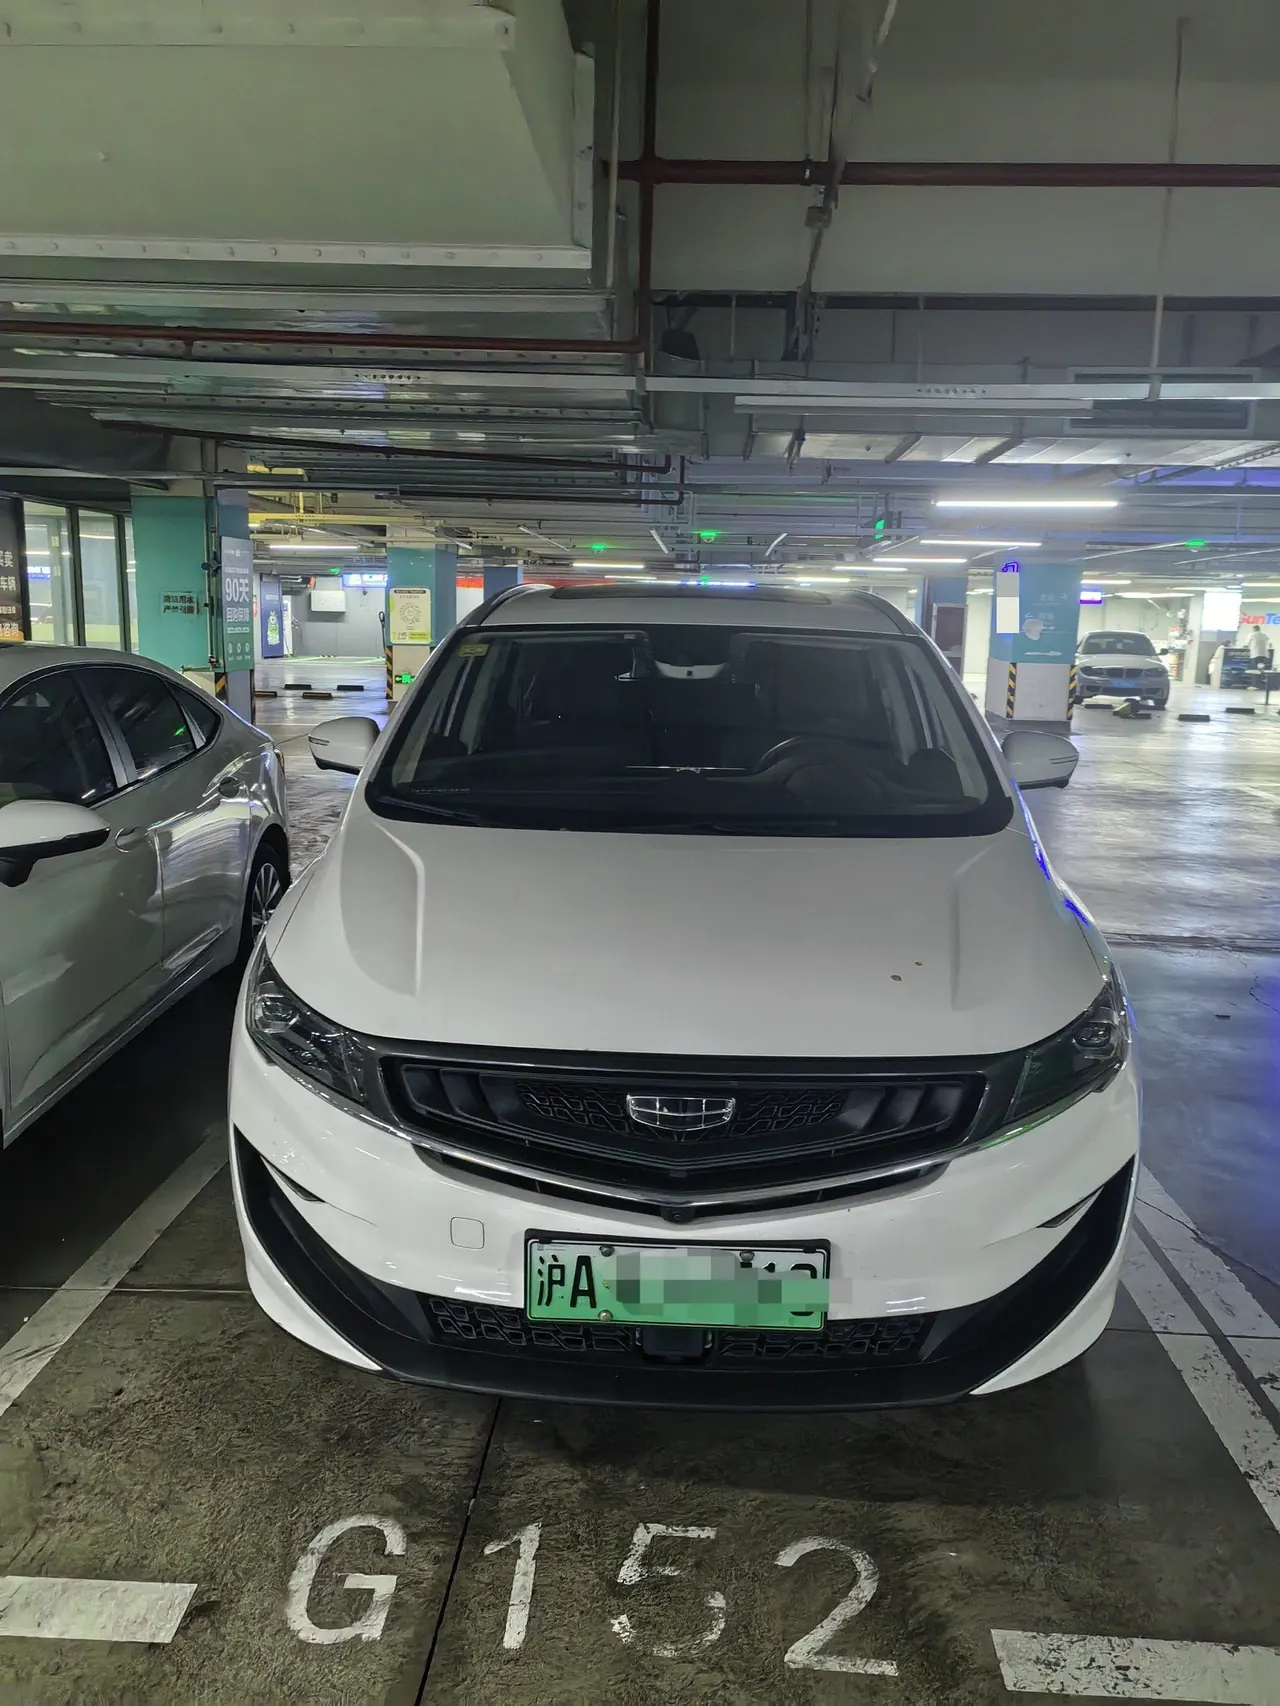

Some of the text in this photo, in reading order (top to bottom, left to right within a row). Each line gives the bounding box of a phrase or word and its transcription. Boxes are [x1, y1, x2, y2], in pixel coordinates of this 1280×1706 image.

[225, 577, 250, 603] 90天
[0, 622, 19, 637] 咨询
[287, 1513, 899, 1677] G152
